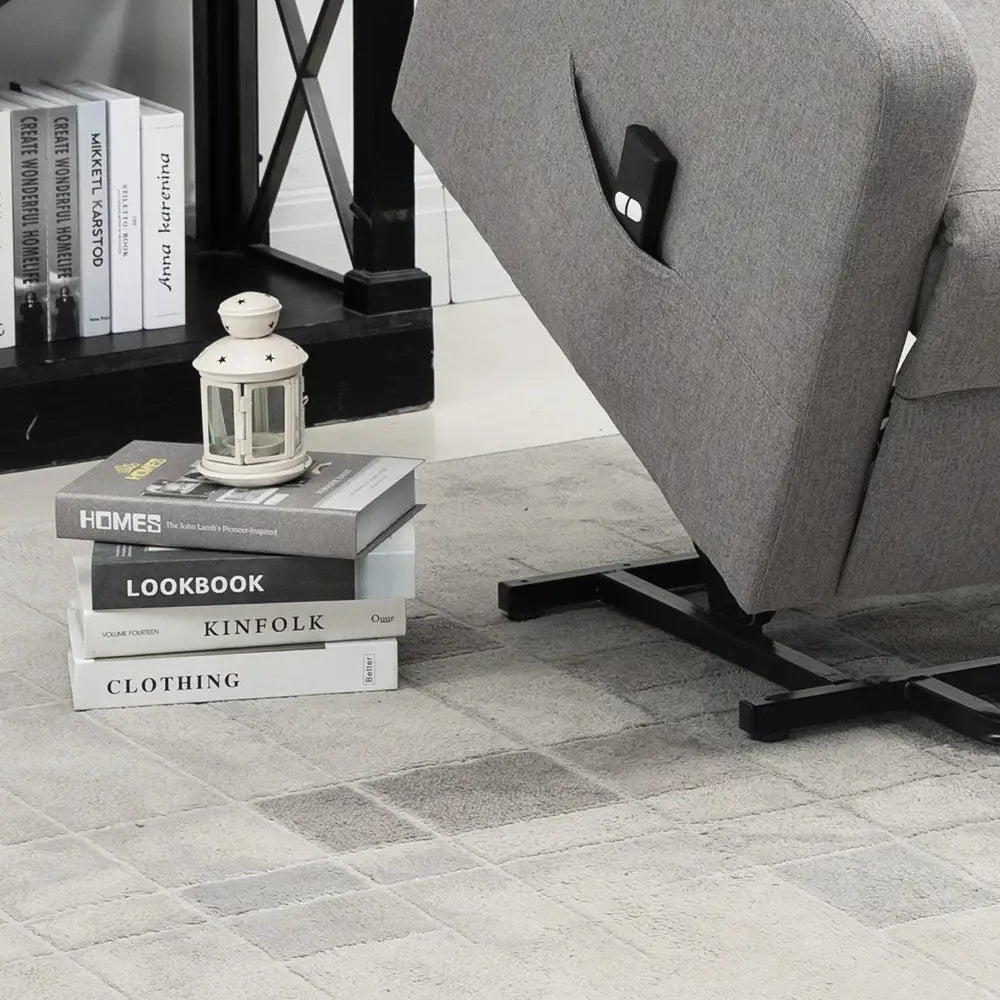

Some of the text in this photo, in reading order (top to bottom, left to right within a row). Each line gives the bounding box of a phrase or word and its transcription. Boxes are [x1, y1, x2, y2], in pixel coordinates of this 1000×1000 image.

[20, 116, 40, 284] CREATE WONDERFUL HOMELIFE
[54, 116, 72, 279] CREATE WONDERFUL HOMELIFE
[90, 132, 104, 267] MIKKETL KARSTOD
[157, 153, 172, 291] Anna karenina
[80, 510, 161, 533] HOMES
[166, 521, 179, 529] The
[126, 574, 264, 597] LOOKBOOK
[203, 614, 325, 637] KINFOLK
[365, 657, 373, 683] Better
[107, 672, 240, 695] CLOTHING
